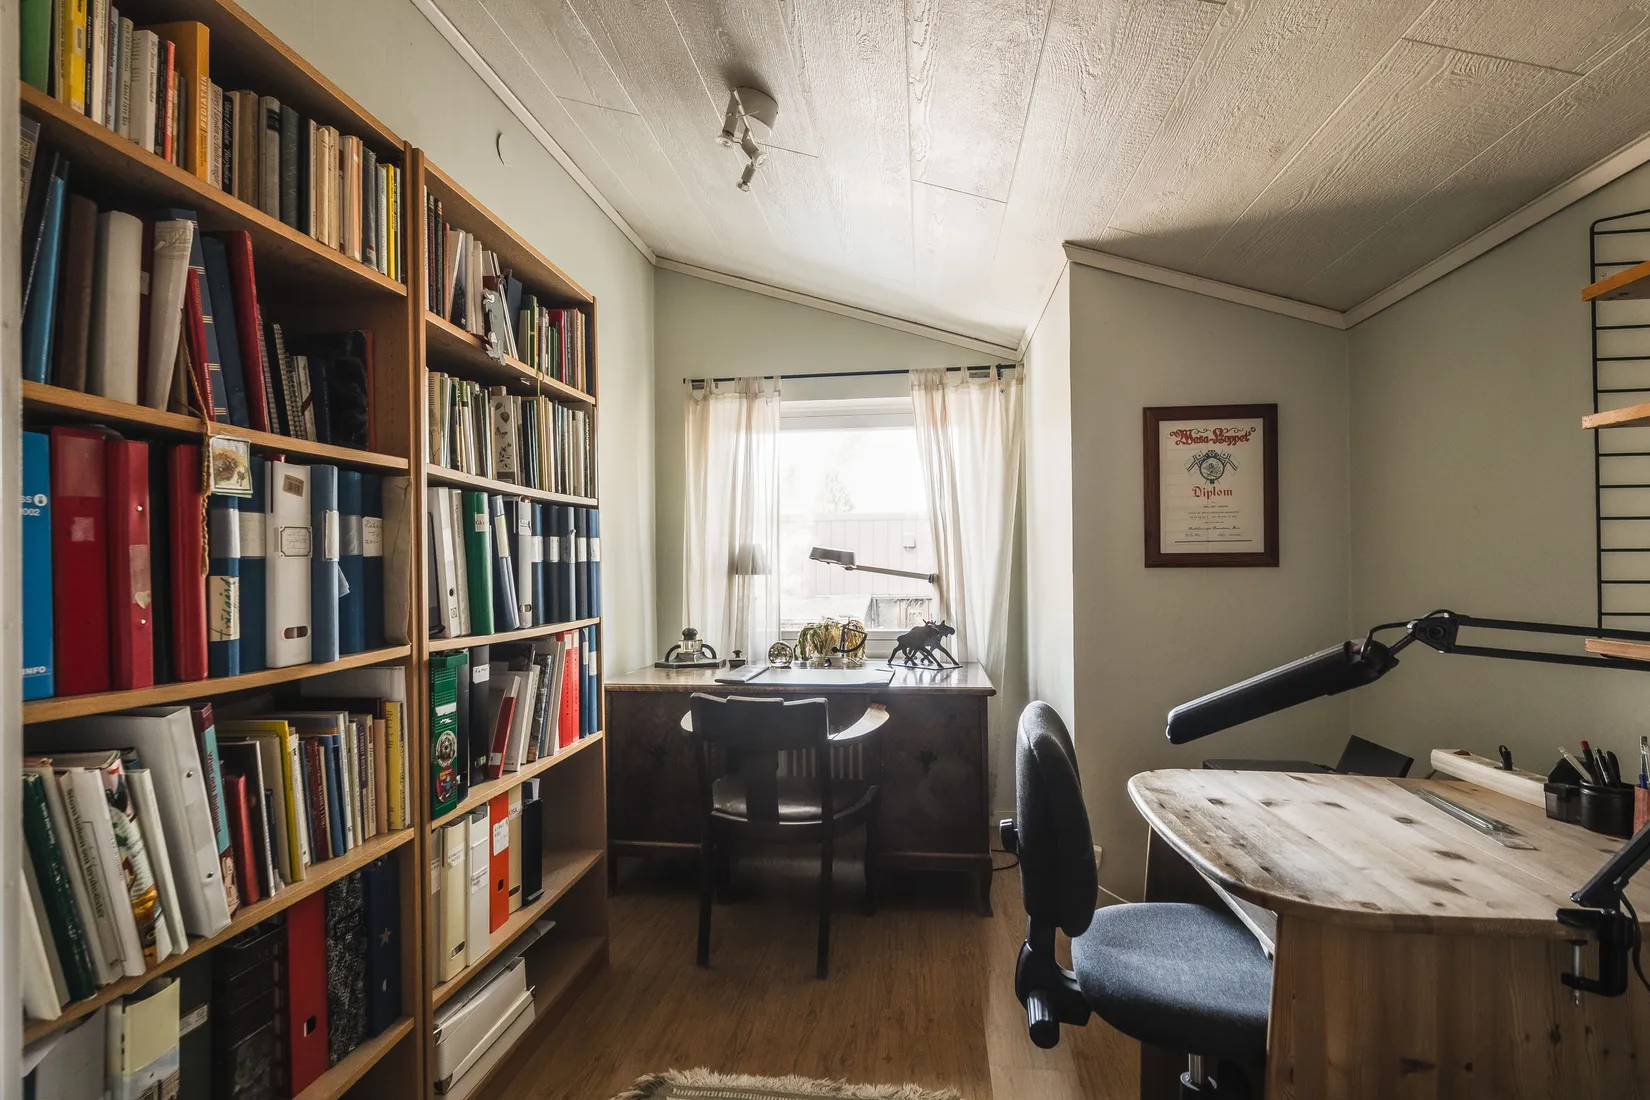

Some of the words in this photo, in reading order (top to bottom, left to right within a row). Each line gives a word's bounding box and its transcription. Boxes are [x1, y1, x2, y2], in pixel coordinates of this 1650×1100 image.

[200, 74, 208, 128] PEDIATRIK
[1192, 485, 1233, 500] Diplom
[207, 751, 215, 775] Wien
[209, 777, 217, 792] och
[211, 793, 222, 834] Budapest
